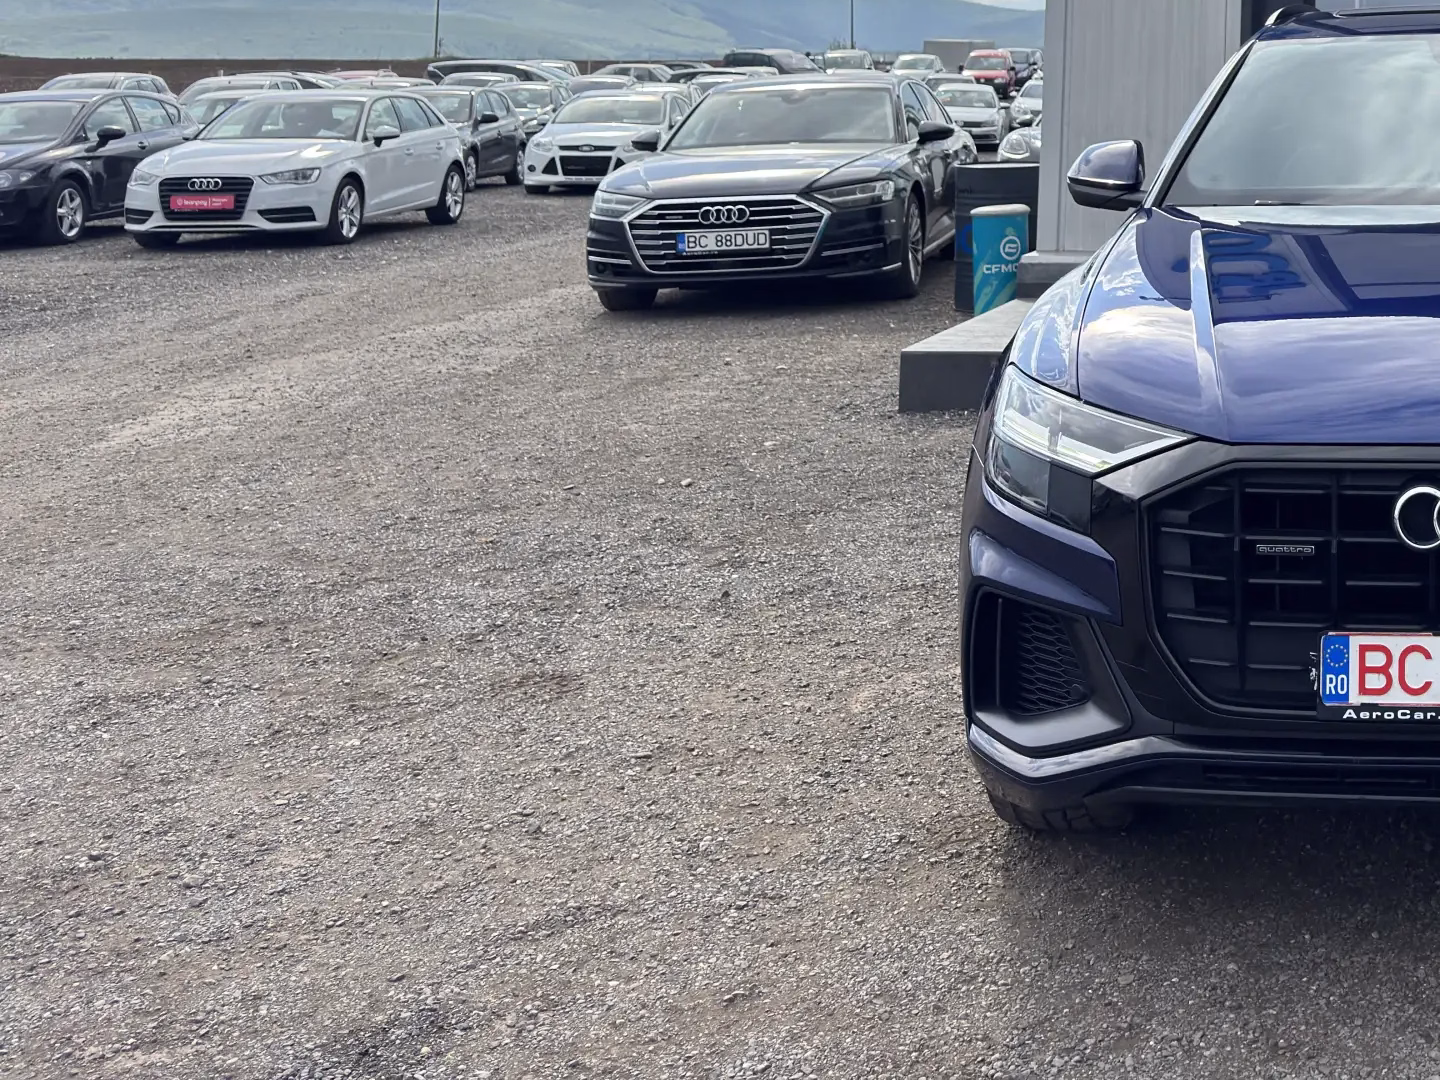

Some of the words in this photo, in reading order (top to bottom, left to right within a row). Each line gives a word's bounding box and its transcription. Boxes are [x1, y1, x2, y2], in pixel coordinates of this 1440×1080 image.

[686, 235, 709, 249] BC
[715, 232, 768, 248] 88DUD
[1259, 546, 1312, 554] quattro
[1357, 644, 1433, 697] BC
[1325, 674, 1348, 695] RO
